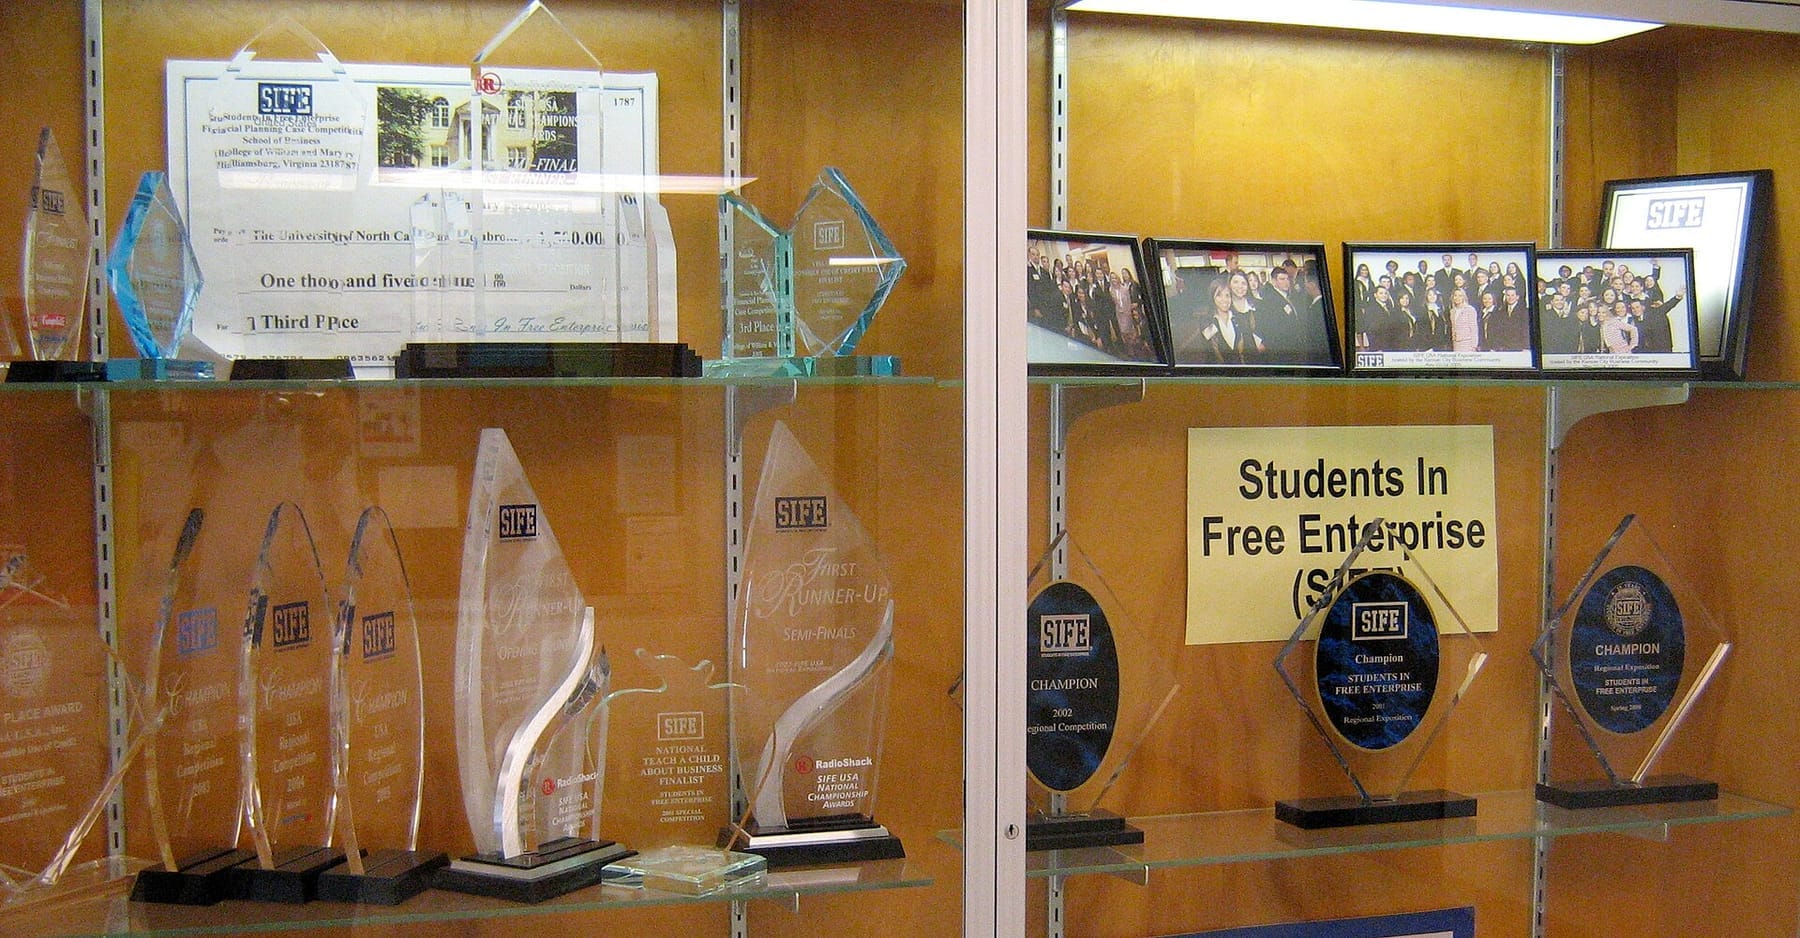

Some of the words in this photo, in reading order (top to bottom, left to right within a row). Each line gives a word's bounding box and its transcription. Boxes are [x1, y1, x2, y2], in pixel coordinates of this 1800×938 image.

[259, 84, 312, 115] SIFE
[614, 98, 635, 107] 1787
[244, 124, 283, 134] Planning
[285, 125, 305, 133] Case
[242, 136, 271, 145] School
[274, 136, 281, 144] of
[319, 148, 342, 158] Mary
[283, 159, 318, 168] Virginia
[320, 159, 345, 168] 23187
[1648, 197, 1705, 229] SIFE
[356, 230, 390, 241] North
[819, 226, 840, 244] SIFE
[261, 273, 295, 288] One
[382, 273, 412, 288] five
[569, 283, 592, 291] Dollars
[261, 314, 310, 330] Third
[738, 321, 752, 334] 3rd
[754, 320, 775, 333] Place
[1357, 353, 1384, 367] SIFE
[1239, 458, 1404, 499] Students
[1418, 457, 1448, 495] In
[776, 497, 826, 528] SIFE
[501, 506, 536, 537] SIFE
[1203, 516, 1285, 556] Free
[1299, 511, 1485, 560] Enterprise
[803, 548, 857, 585] FIRST
[1616, 601, 1640, 616] SIFE
[273, 602, 310, 646] SIFE
[1361, 609, 1400, 633] SIFE
[362, 613, 395, 656] SIFE
[784, 626, 857, 641] SEMI-FINALS
[1042, 616, 1089, 650] SIFE
[1595, 643, 1661, 656] CHAMPION
[1355, 653, 1404, 665] Champion
[1594, 664, 1623, 673] Regional
[1625, 663, 1660, 672] Exposition
[1348, 673, 1397, 683] STUDENTS
[1400, 672, 1410, 681] IN
[1605, 678, 1640, 686] STUDENTS
[1031, 678, 1098, 690] CHAMPION
[1335, 685, 1361, 695] FREE
[1363, 683, 1422, 694] ENTERPRISE
[1596, 687, 1613, 695] FREE
[1615, 686, 1657, 695] ENTERPRISE
[44, 701, 83, 716] AWARD
[1052, 708, 1073, 717] 2002
[1344, 715, 1375, 725] Regional
[1376, 714, 1413, 723] Exposition
[664, 717, 697, 735] SIFE
[1027, 723, 1056, 735] egional
[1058, 722, 1107, 734] Competition
[656, 745, 706, 755] NATIONAL
[643, 757, 677, 766] TEACH
[688, 754, 720, 763] CHILD
[816, 756, 873, 770] RadioShack
[641, 767, 674, 776] ABOUT
[677, 764, 723, 774] BUSINESS
[660, 775, 704, 786] FINALIST
[817, 774, 837, 783] SIFE
[839, 773, 859, 782] USA
[818, 782, 859, 792] NATIONAL
[660, 790, 695, 798] STUDENTS
[807, 790, 869, 801] CHAMPIONSHIP
[823, 799, 855, 809] AWARDS
[660, 815, 705, 823] COMPETITION
